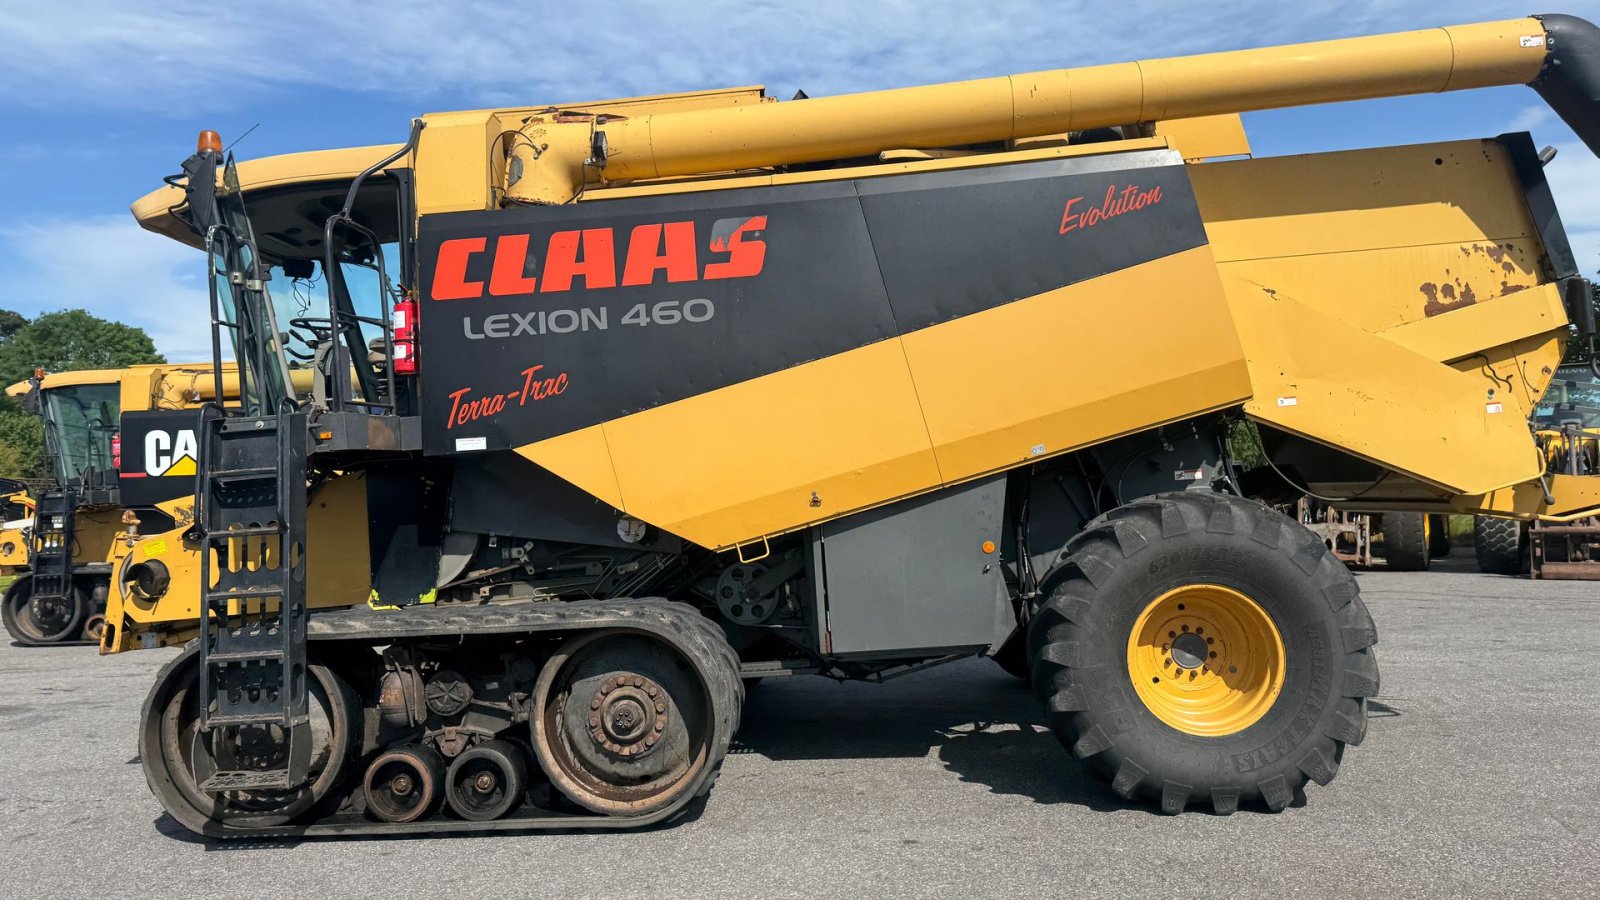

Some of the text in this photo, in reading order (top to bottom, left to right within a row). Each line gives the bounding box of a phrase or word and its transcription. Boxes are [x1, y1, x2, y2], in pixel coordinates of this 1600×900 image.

[1059, 184, 1163, 235] Evolution
[431, 215, 768, 300] CLAAS
[463, 298, 715, 340] LEXION 460
[447, 364, 569, 429] Terra-Trac
[145, 429, 198, 477] CA
